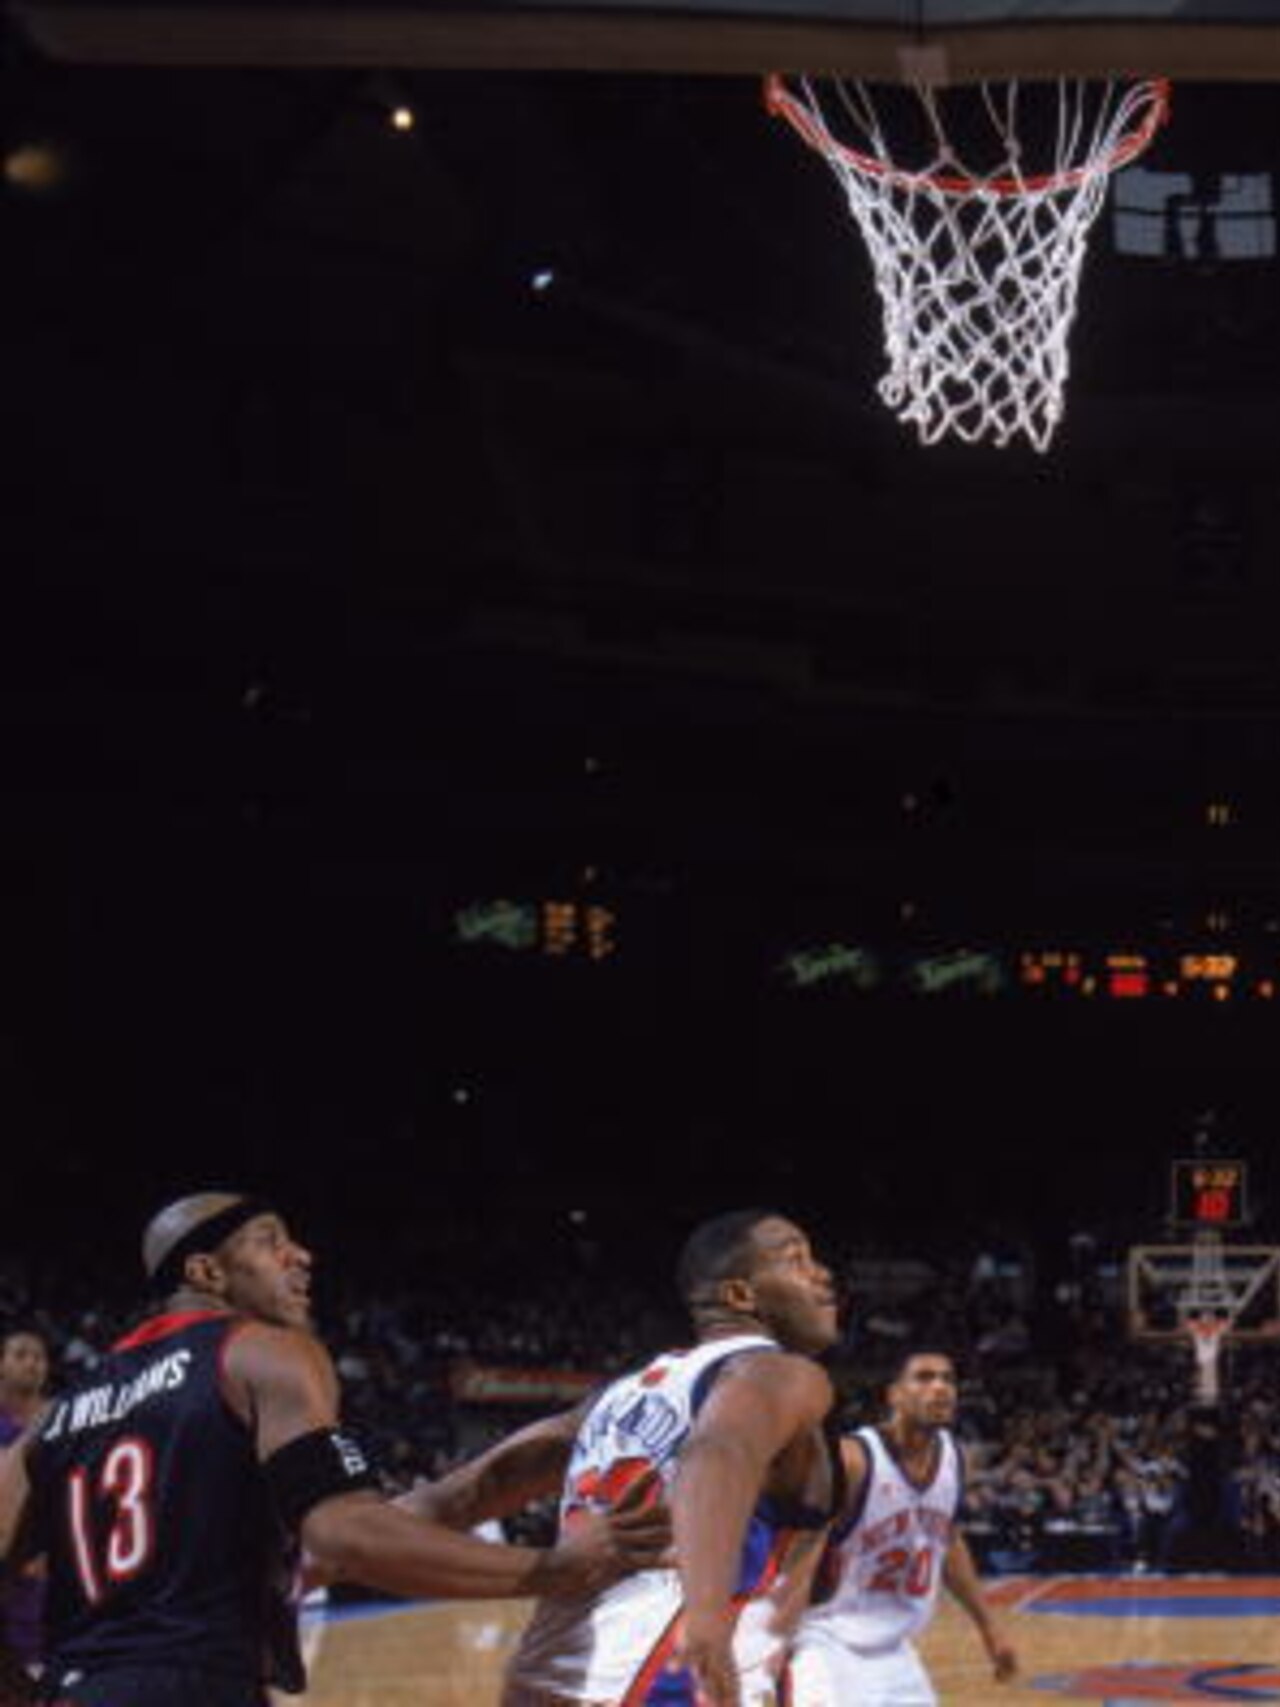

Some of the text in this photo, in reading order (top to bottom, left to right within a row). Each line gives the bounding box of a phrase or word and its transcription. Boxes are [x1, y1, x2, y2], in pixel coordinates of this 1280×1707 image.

[44, 1401, 70, 1441] J
[68, 1438, 155, 1605] 13
[864, 1547, 934, 1598] 20
